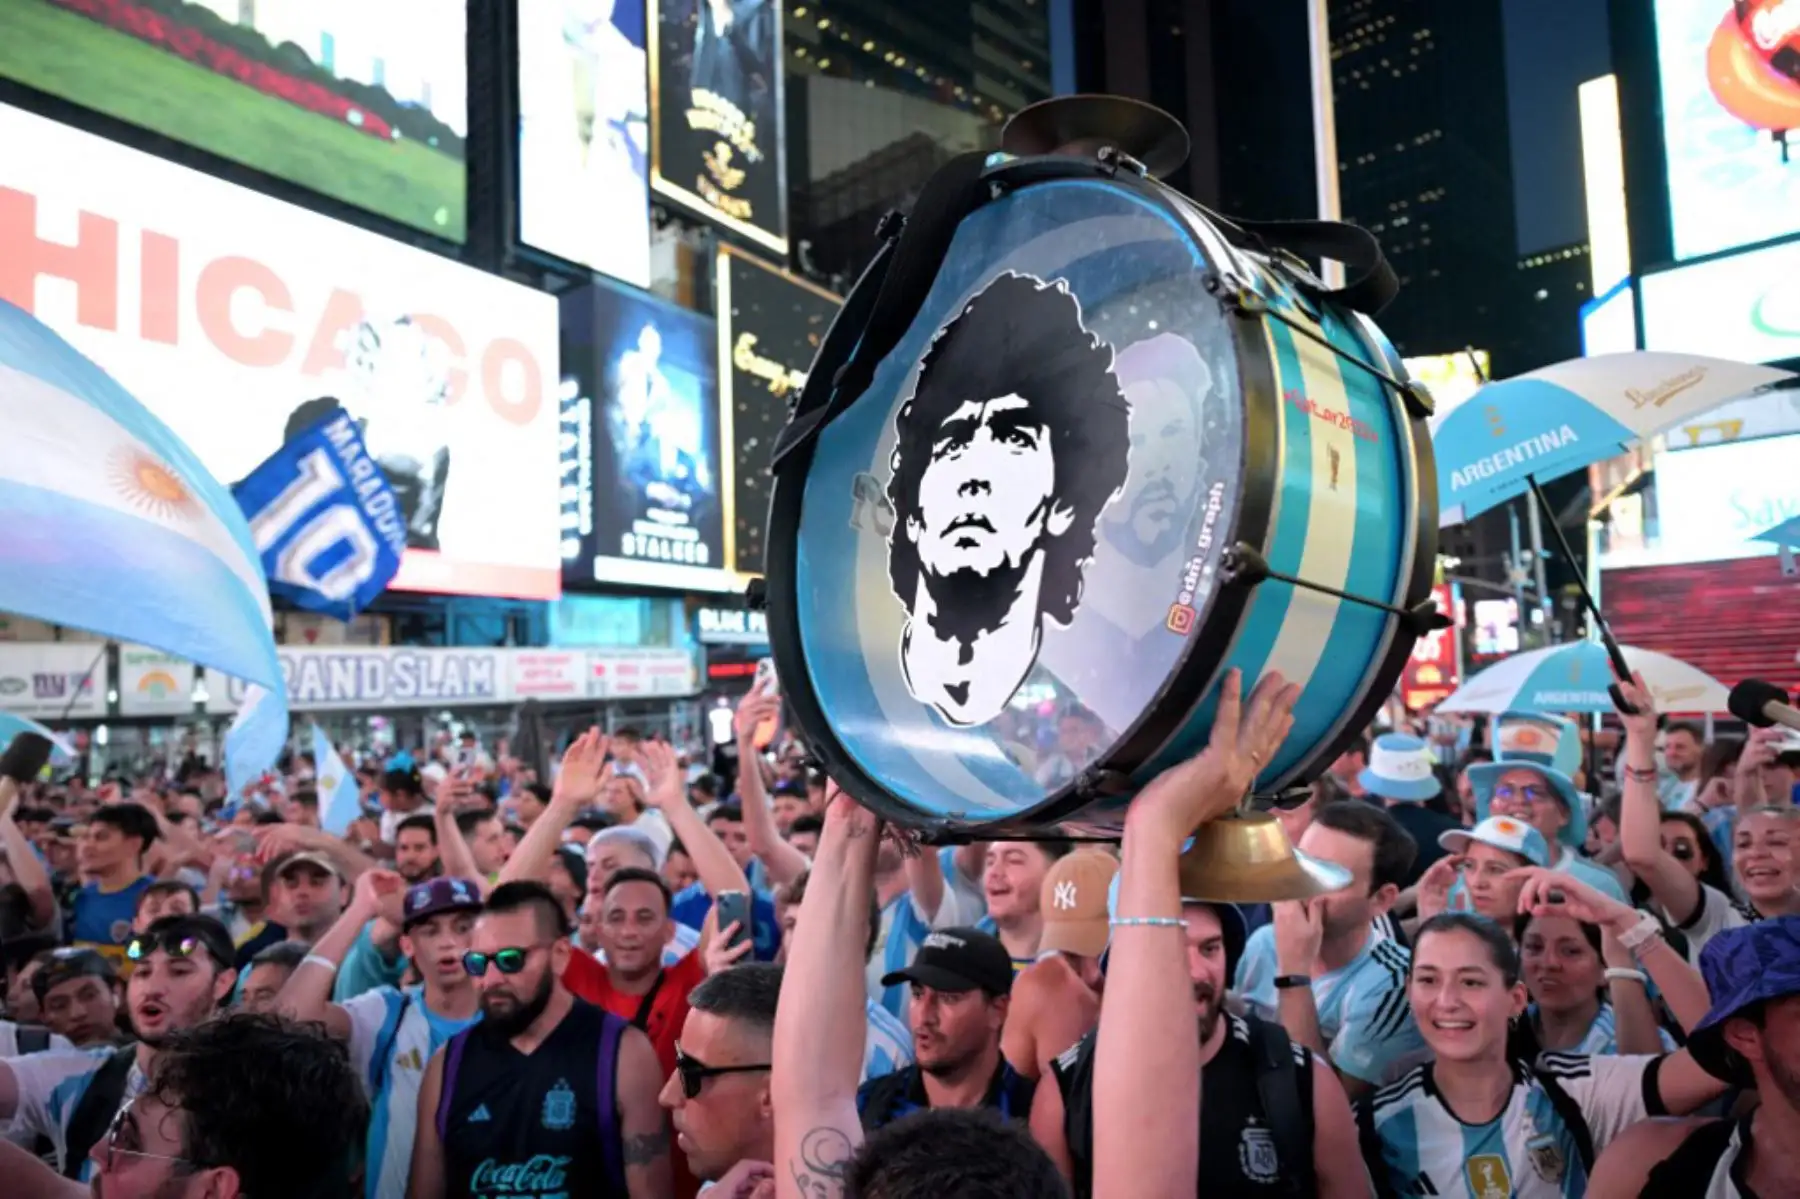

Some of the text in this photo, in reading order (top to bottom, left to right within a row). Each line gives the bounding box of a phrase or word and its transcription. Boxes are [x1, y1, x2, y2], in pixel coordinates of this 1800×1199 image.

[1451, 424, 1578, 491] ARGENTINA
[248, 447, 378, 600] 10
[391, 650, 495, 699] SLAM
[1053, 880, 1077, 910] NY
